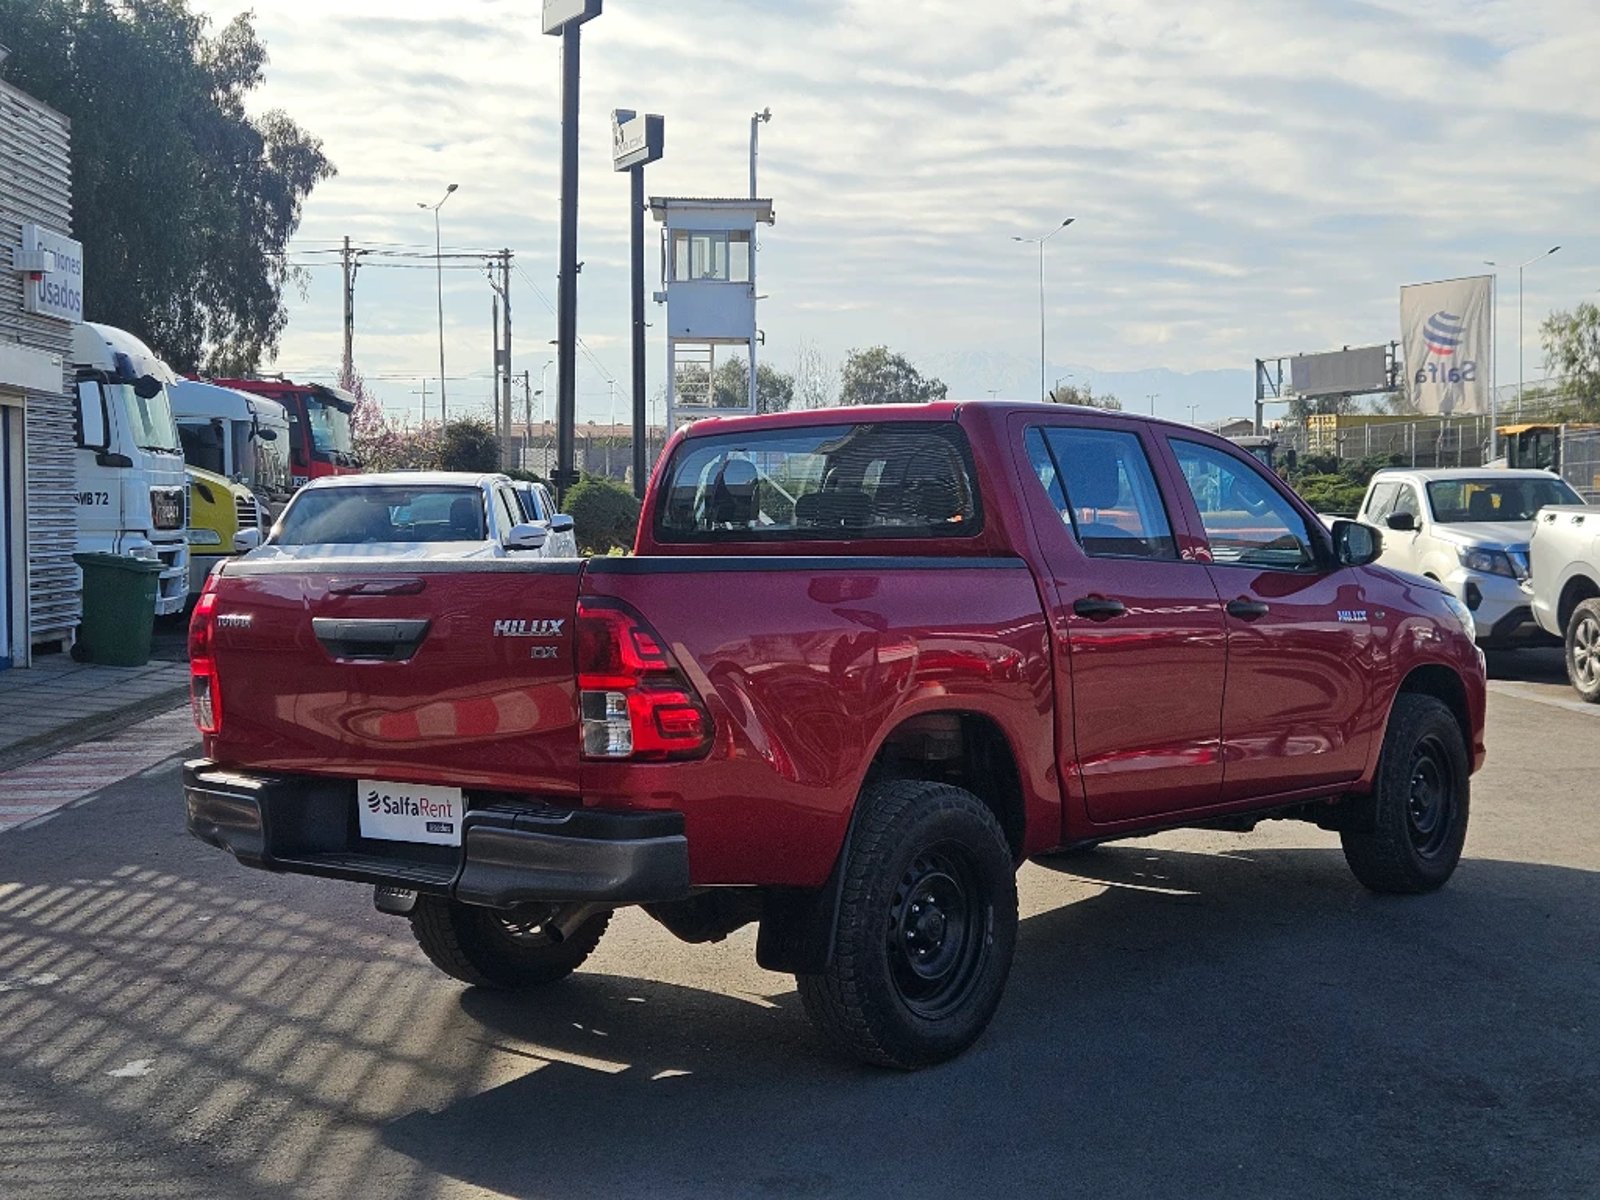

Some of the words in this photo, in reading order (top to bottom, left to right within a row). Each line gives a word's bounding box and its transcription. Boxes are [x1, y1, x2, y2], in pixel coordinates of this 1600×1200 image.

[38, 272, 80, 312] Usados
[493, 619, 565, 637] HILUX
[530, 646, 558, 658] DX
[382, 795, 453, 818] SalfaRent
